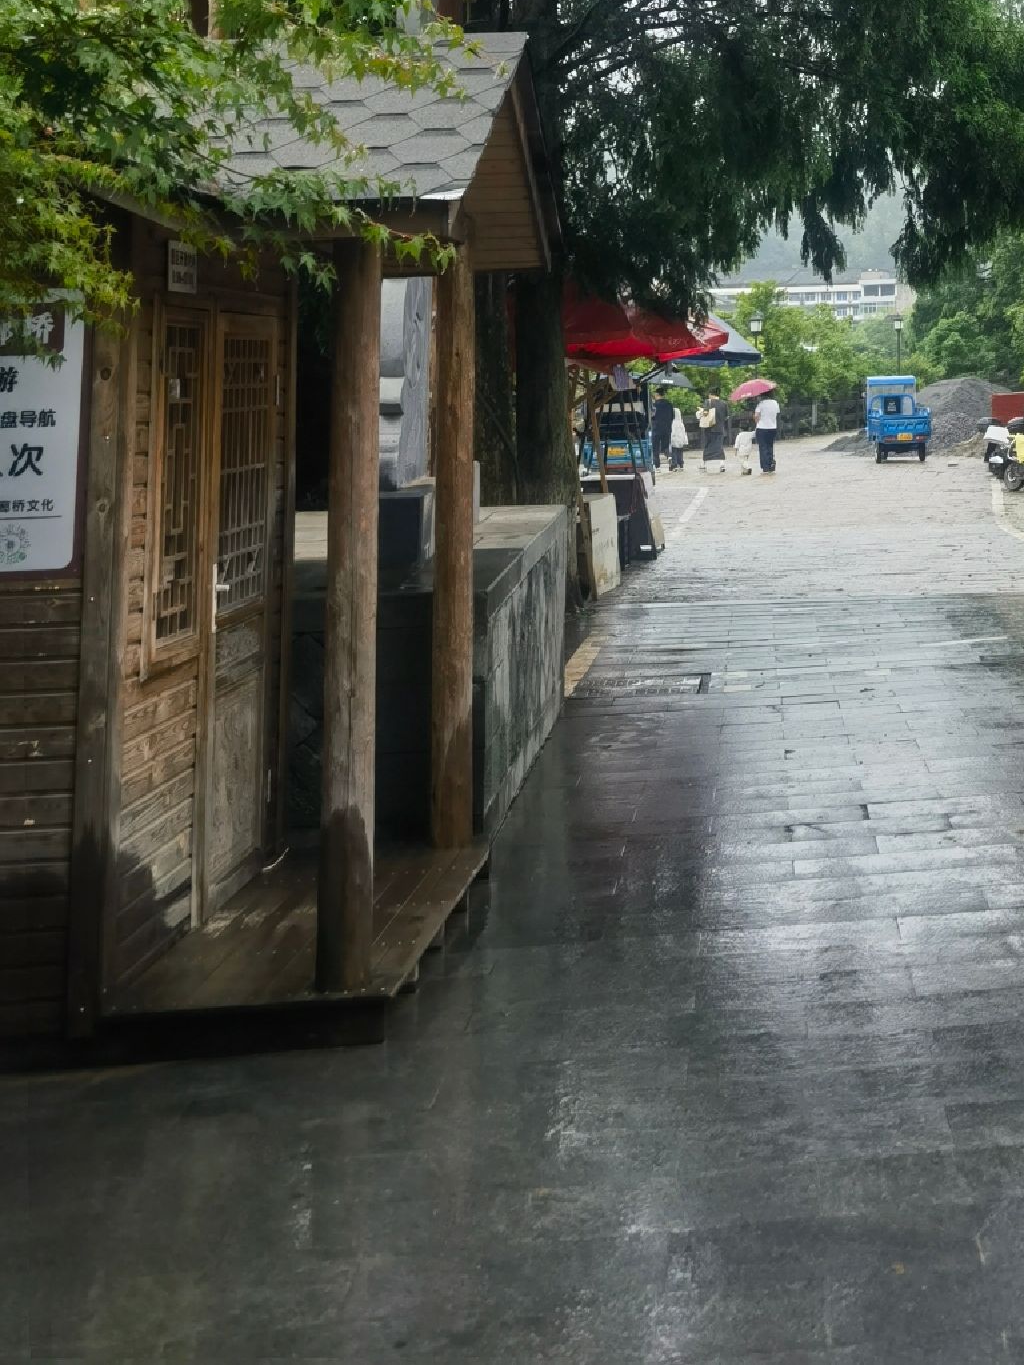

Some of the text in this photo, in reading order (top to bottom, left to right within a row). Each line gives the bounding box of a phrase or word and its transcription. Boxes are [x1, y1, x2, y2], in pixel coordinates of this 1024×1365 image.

[0, 408, 57, 429] 盘导航
[0, 443, 44, 477] 次
